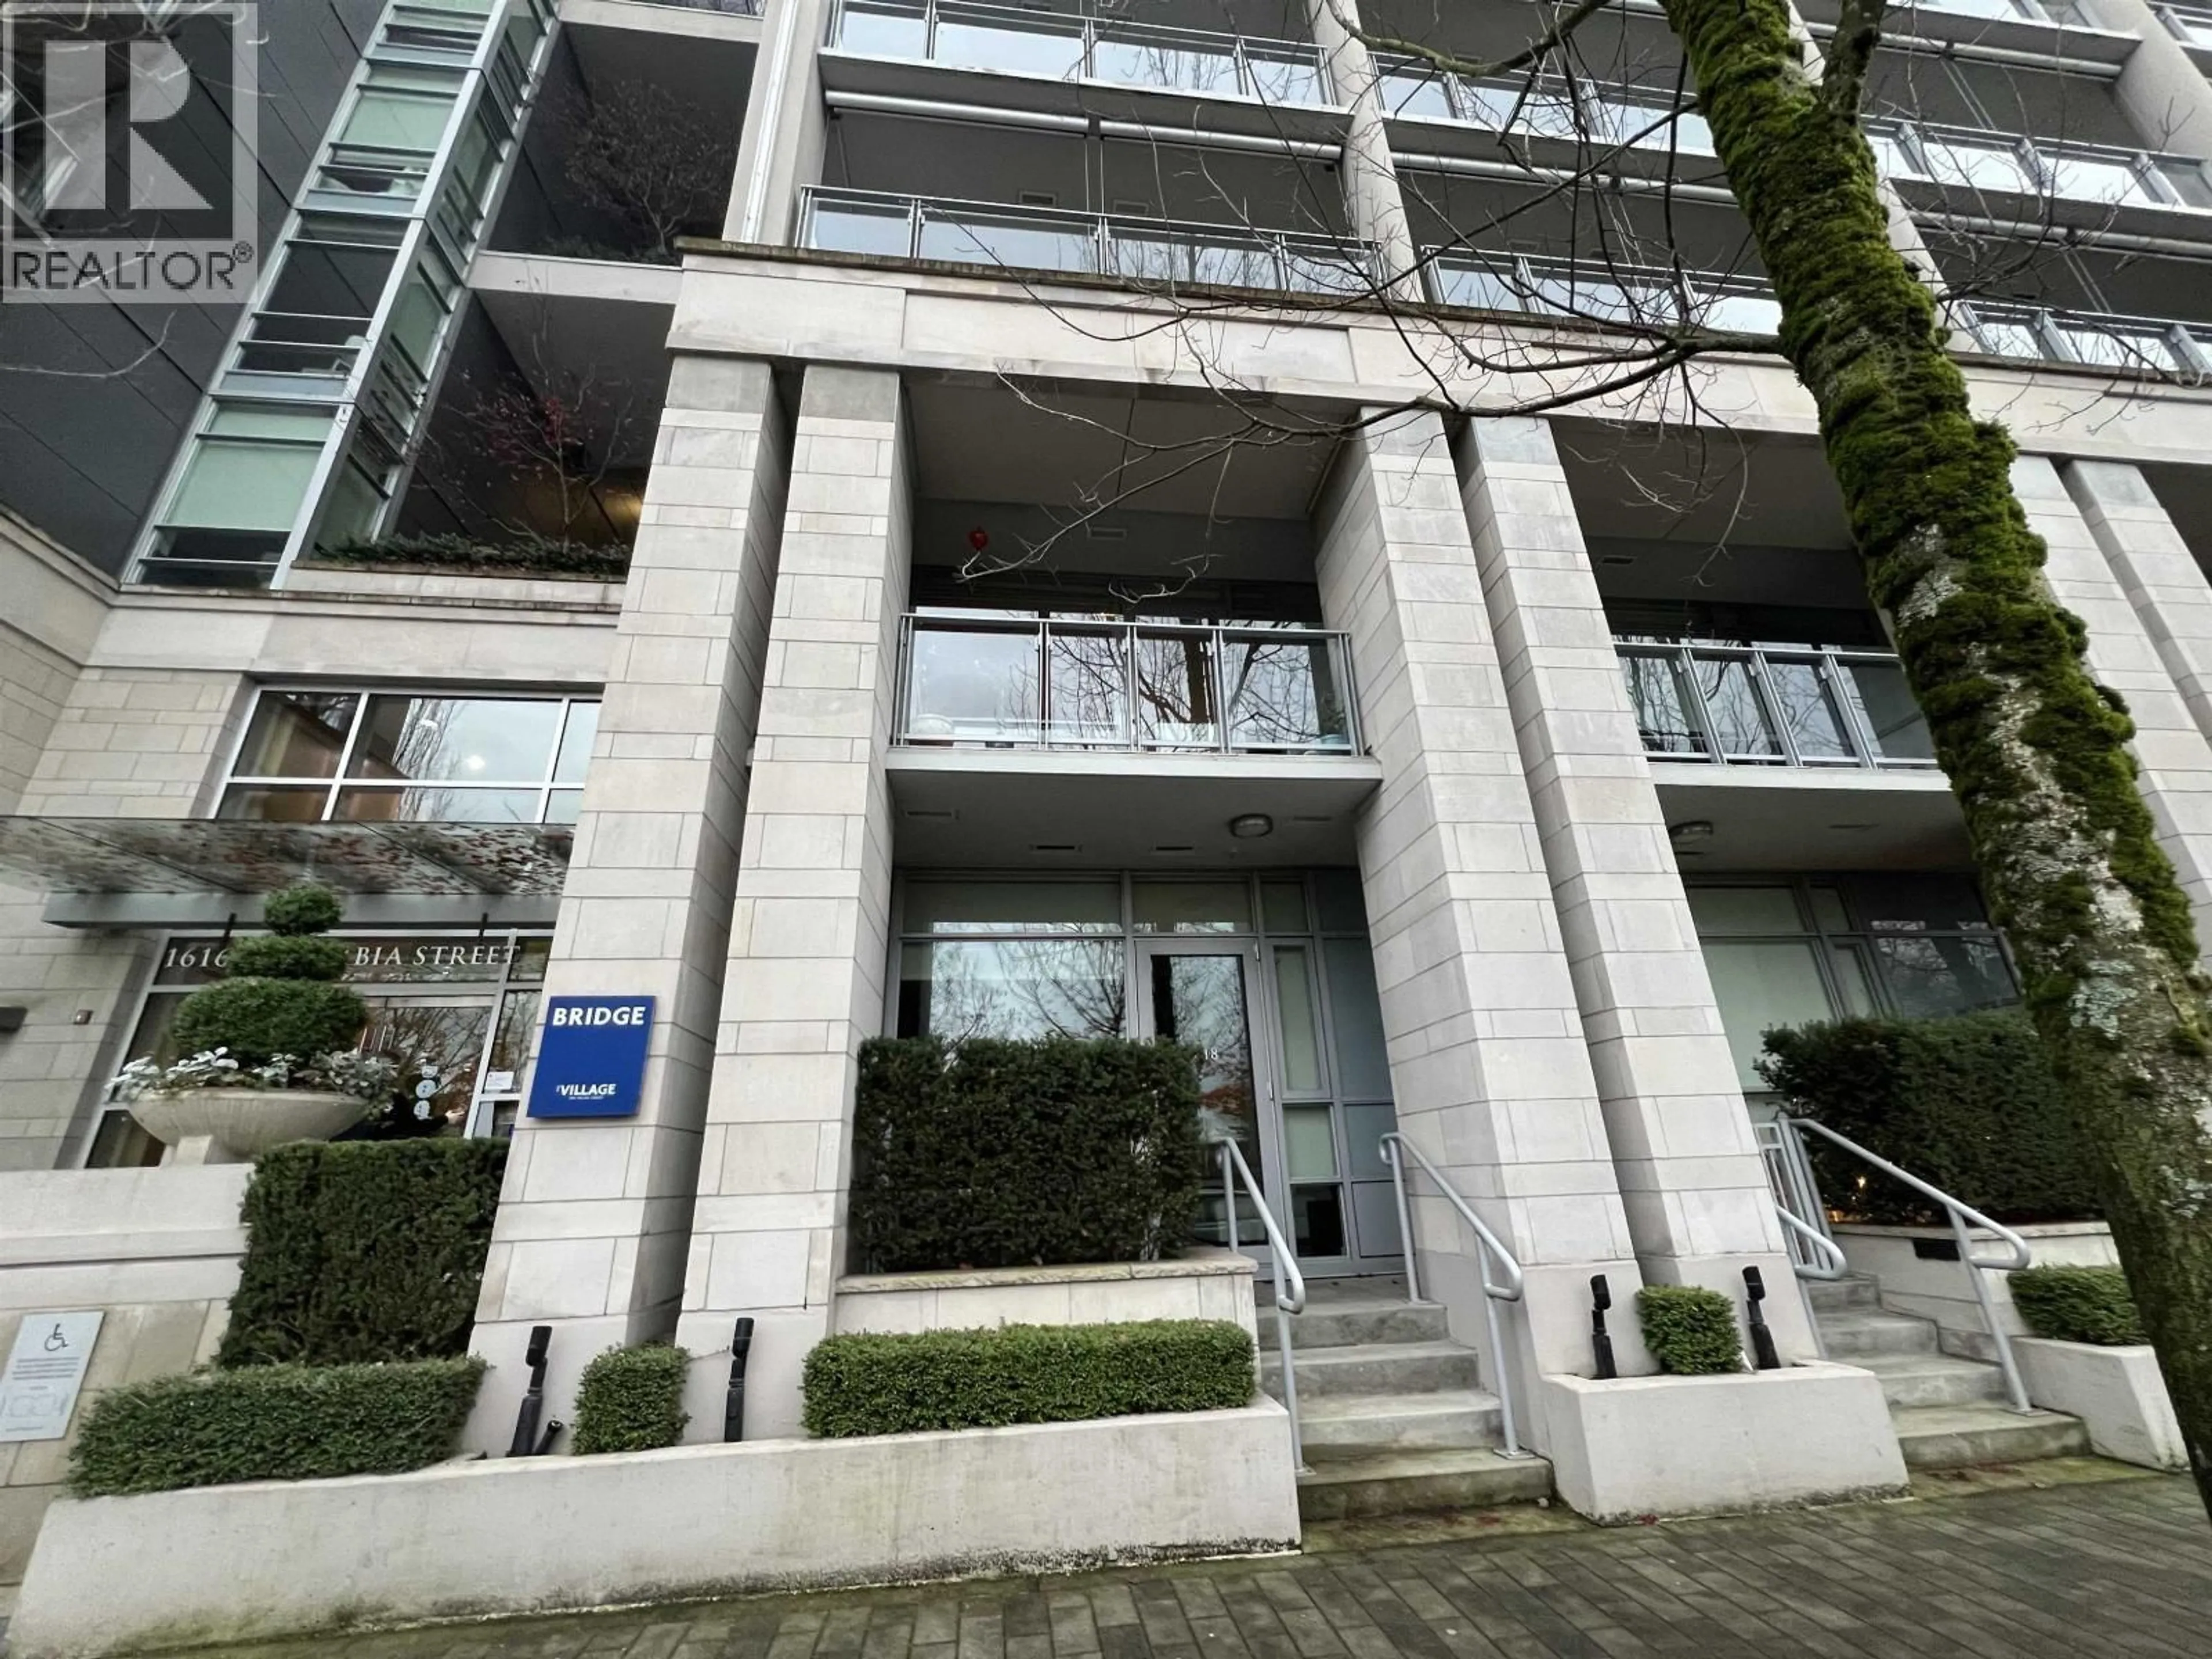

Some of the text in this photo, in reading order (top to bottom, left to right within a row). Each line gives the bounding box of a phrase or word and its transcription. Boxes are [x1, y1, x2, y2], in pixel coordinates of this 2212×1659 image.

[165, 945, 521, 968] 1616 BIA STREET
[552, 1006, 646, 1025] BRIDGE
[561, 1084, 616, 1096] VILLAGE
